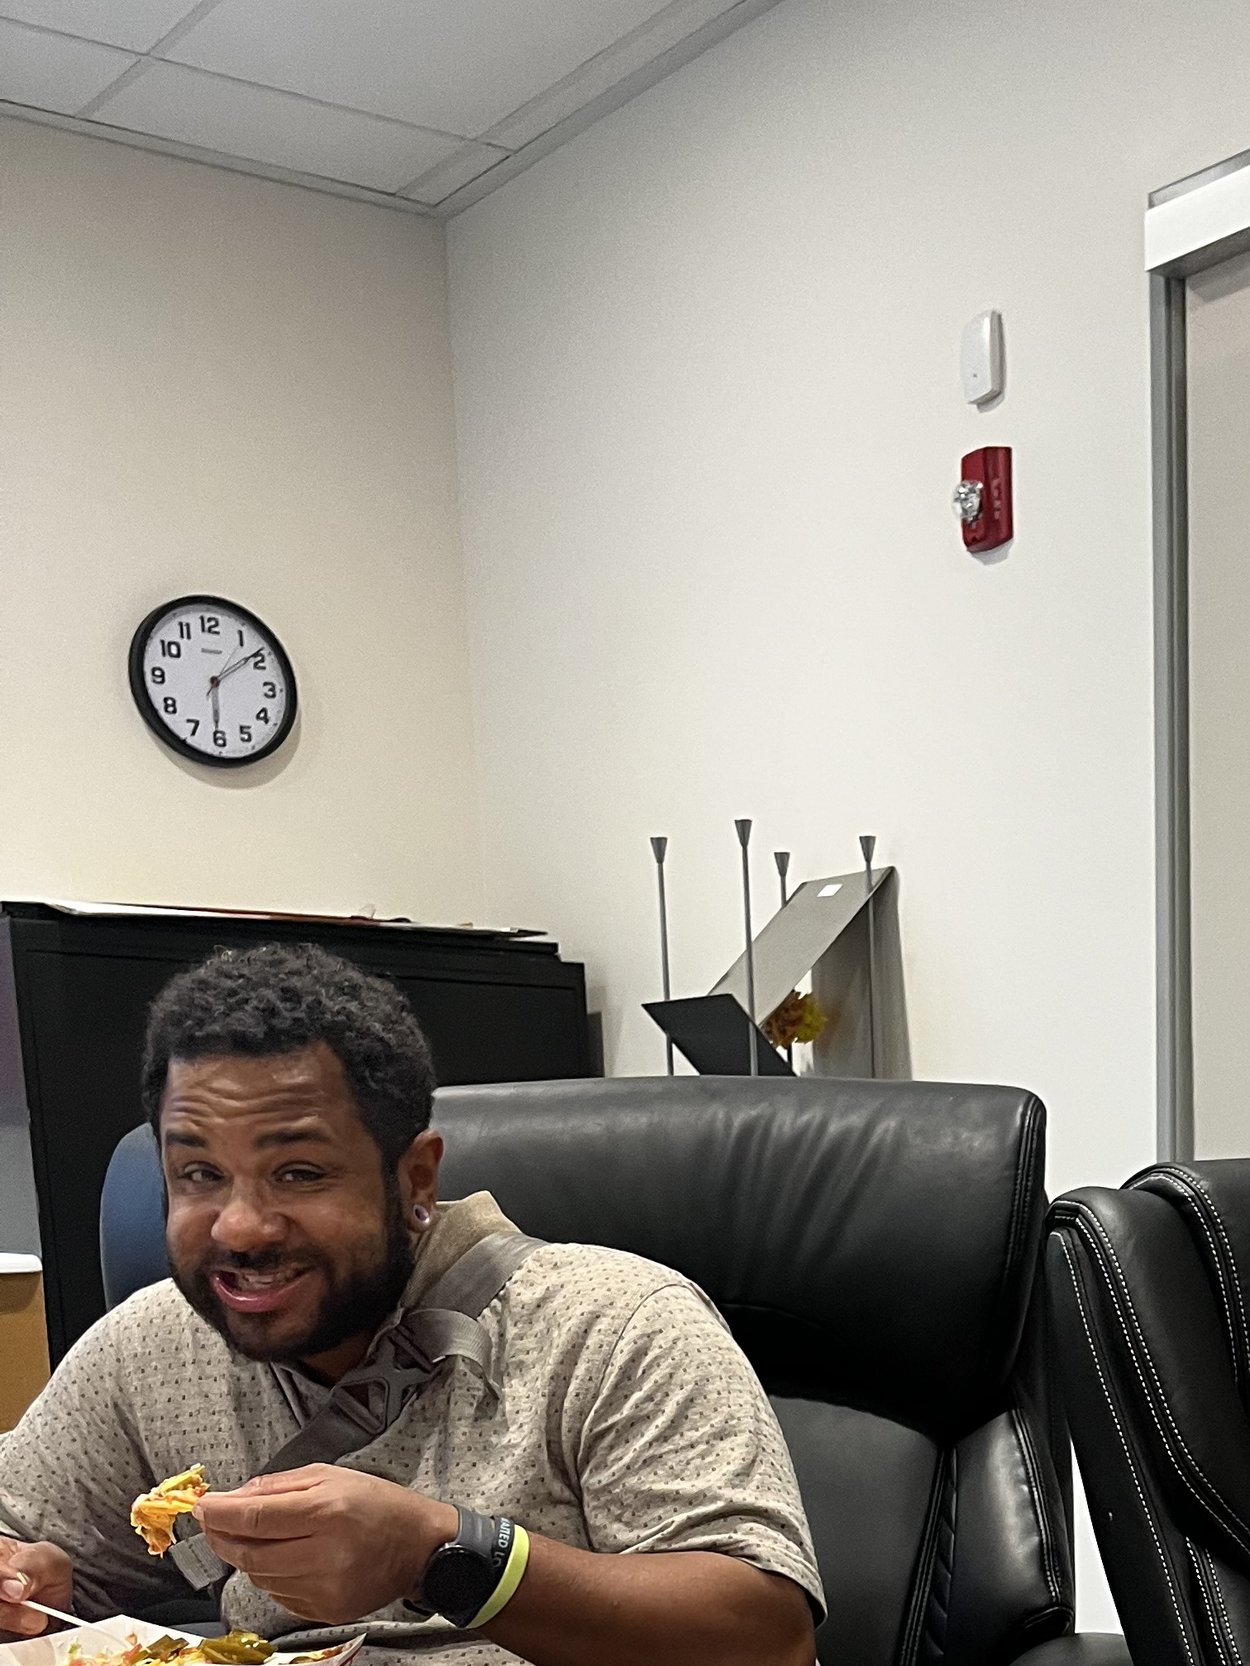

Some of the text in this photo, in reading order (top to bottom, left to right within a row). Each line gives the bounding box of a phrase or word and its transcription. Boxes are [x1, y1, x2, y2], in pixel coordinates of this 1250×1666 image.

[179, 622, 191, 640] 11
[200, 615, 220, 635] 12
[238, 630, 243, 647] 1
[160, 639, 181, 658] 10
[253, 653, 266, 670] 2
[151, 667, 165, 684] 9
[263, 682, 276, 699] 3
[164, 697, 177, 714] 8
[256, 708, 269, 724] 4
[186, 719, 200, 736] 7
[239, 725, 252, 742] 5
[213, 730, 226, 747] 6
